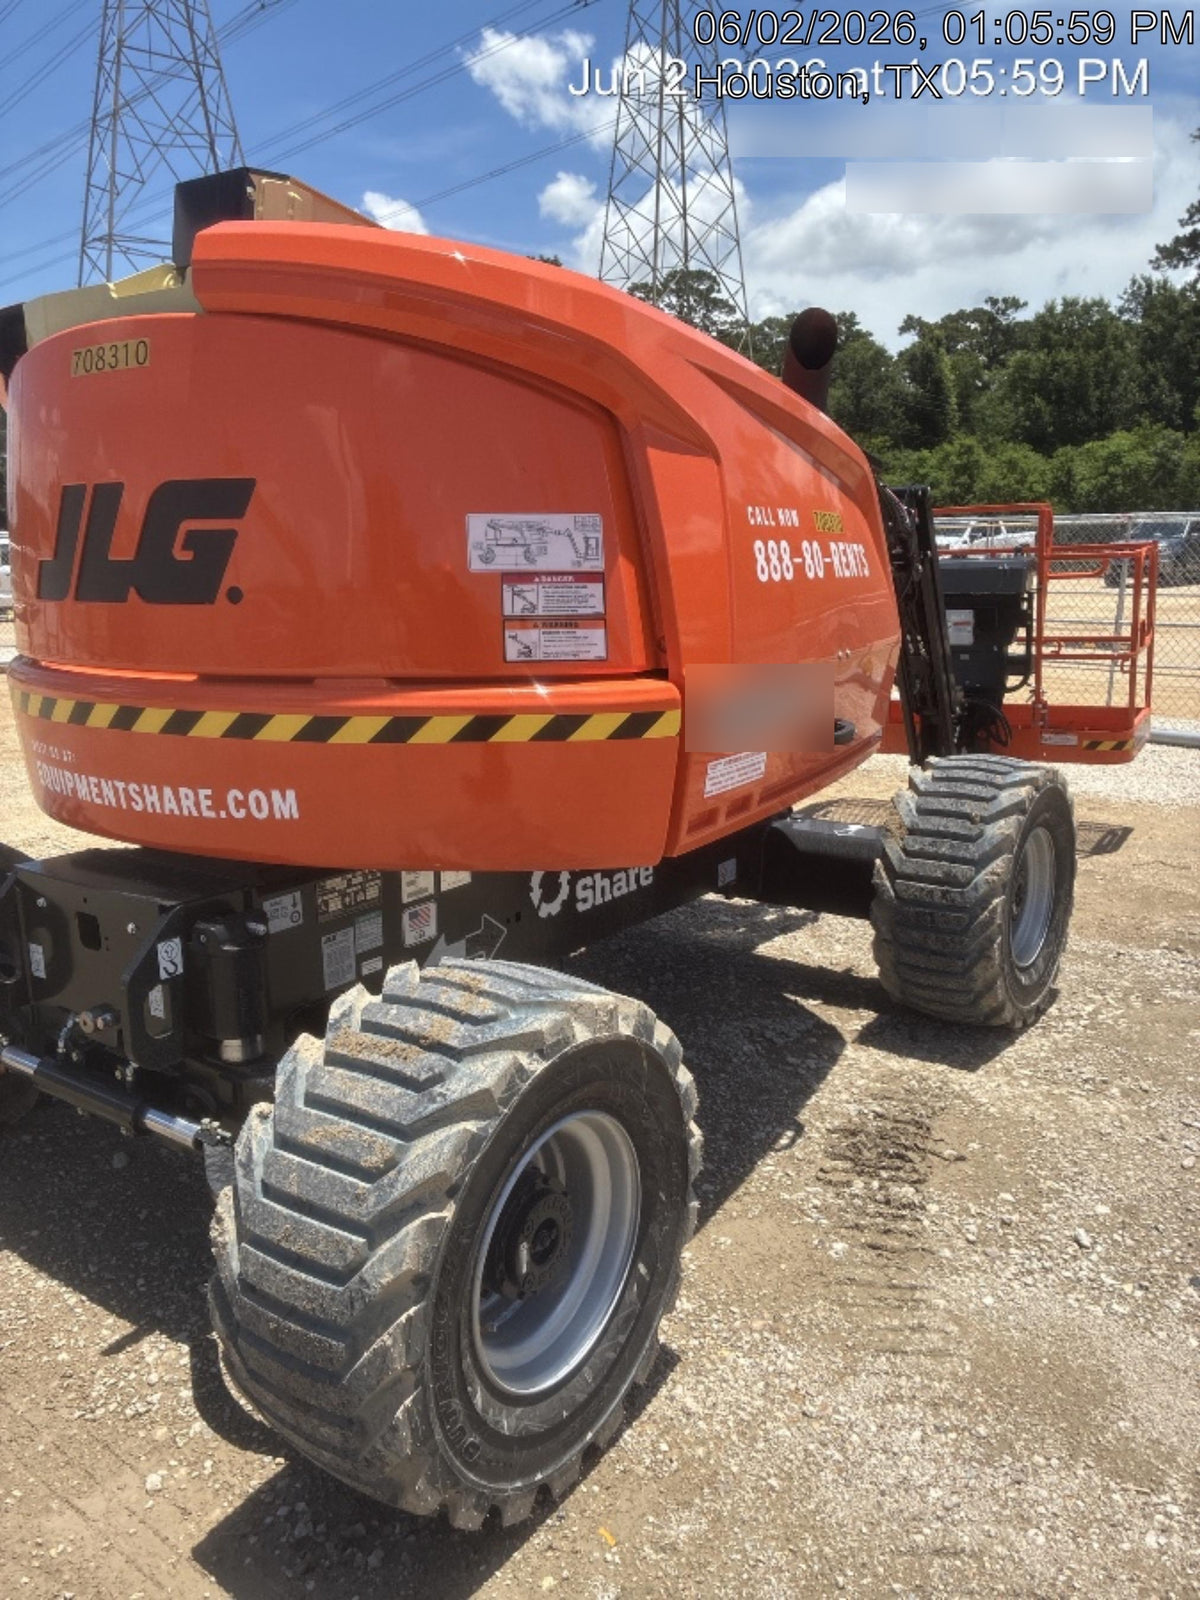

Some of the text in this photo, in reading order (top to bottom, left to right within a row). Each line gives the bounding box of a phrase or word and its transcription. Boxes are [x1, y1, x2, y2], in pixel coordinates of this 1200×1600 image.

[73, 340, 148, 376] 708310
[747, 505, 776, 527] CALL
[777, 507, 800, 528] NOW
[753, 539, 870, 583] 888-80-RENTS
[36, 760, 299, 820] EQUIPMENTSHARE.COM
